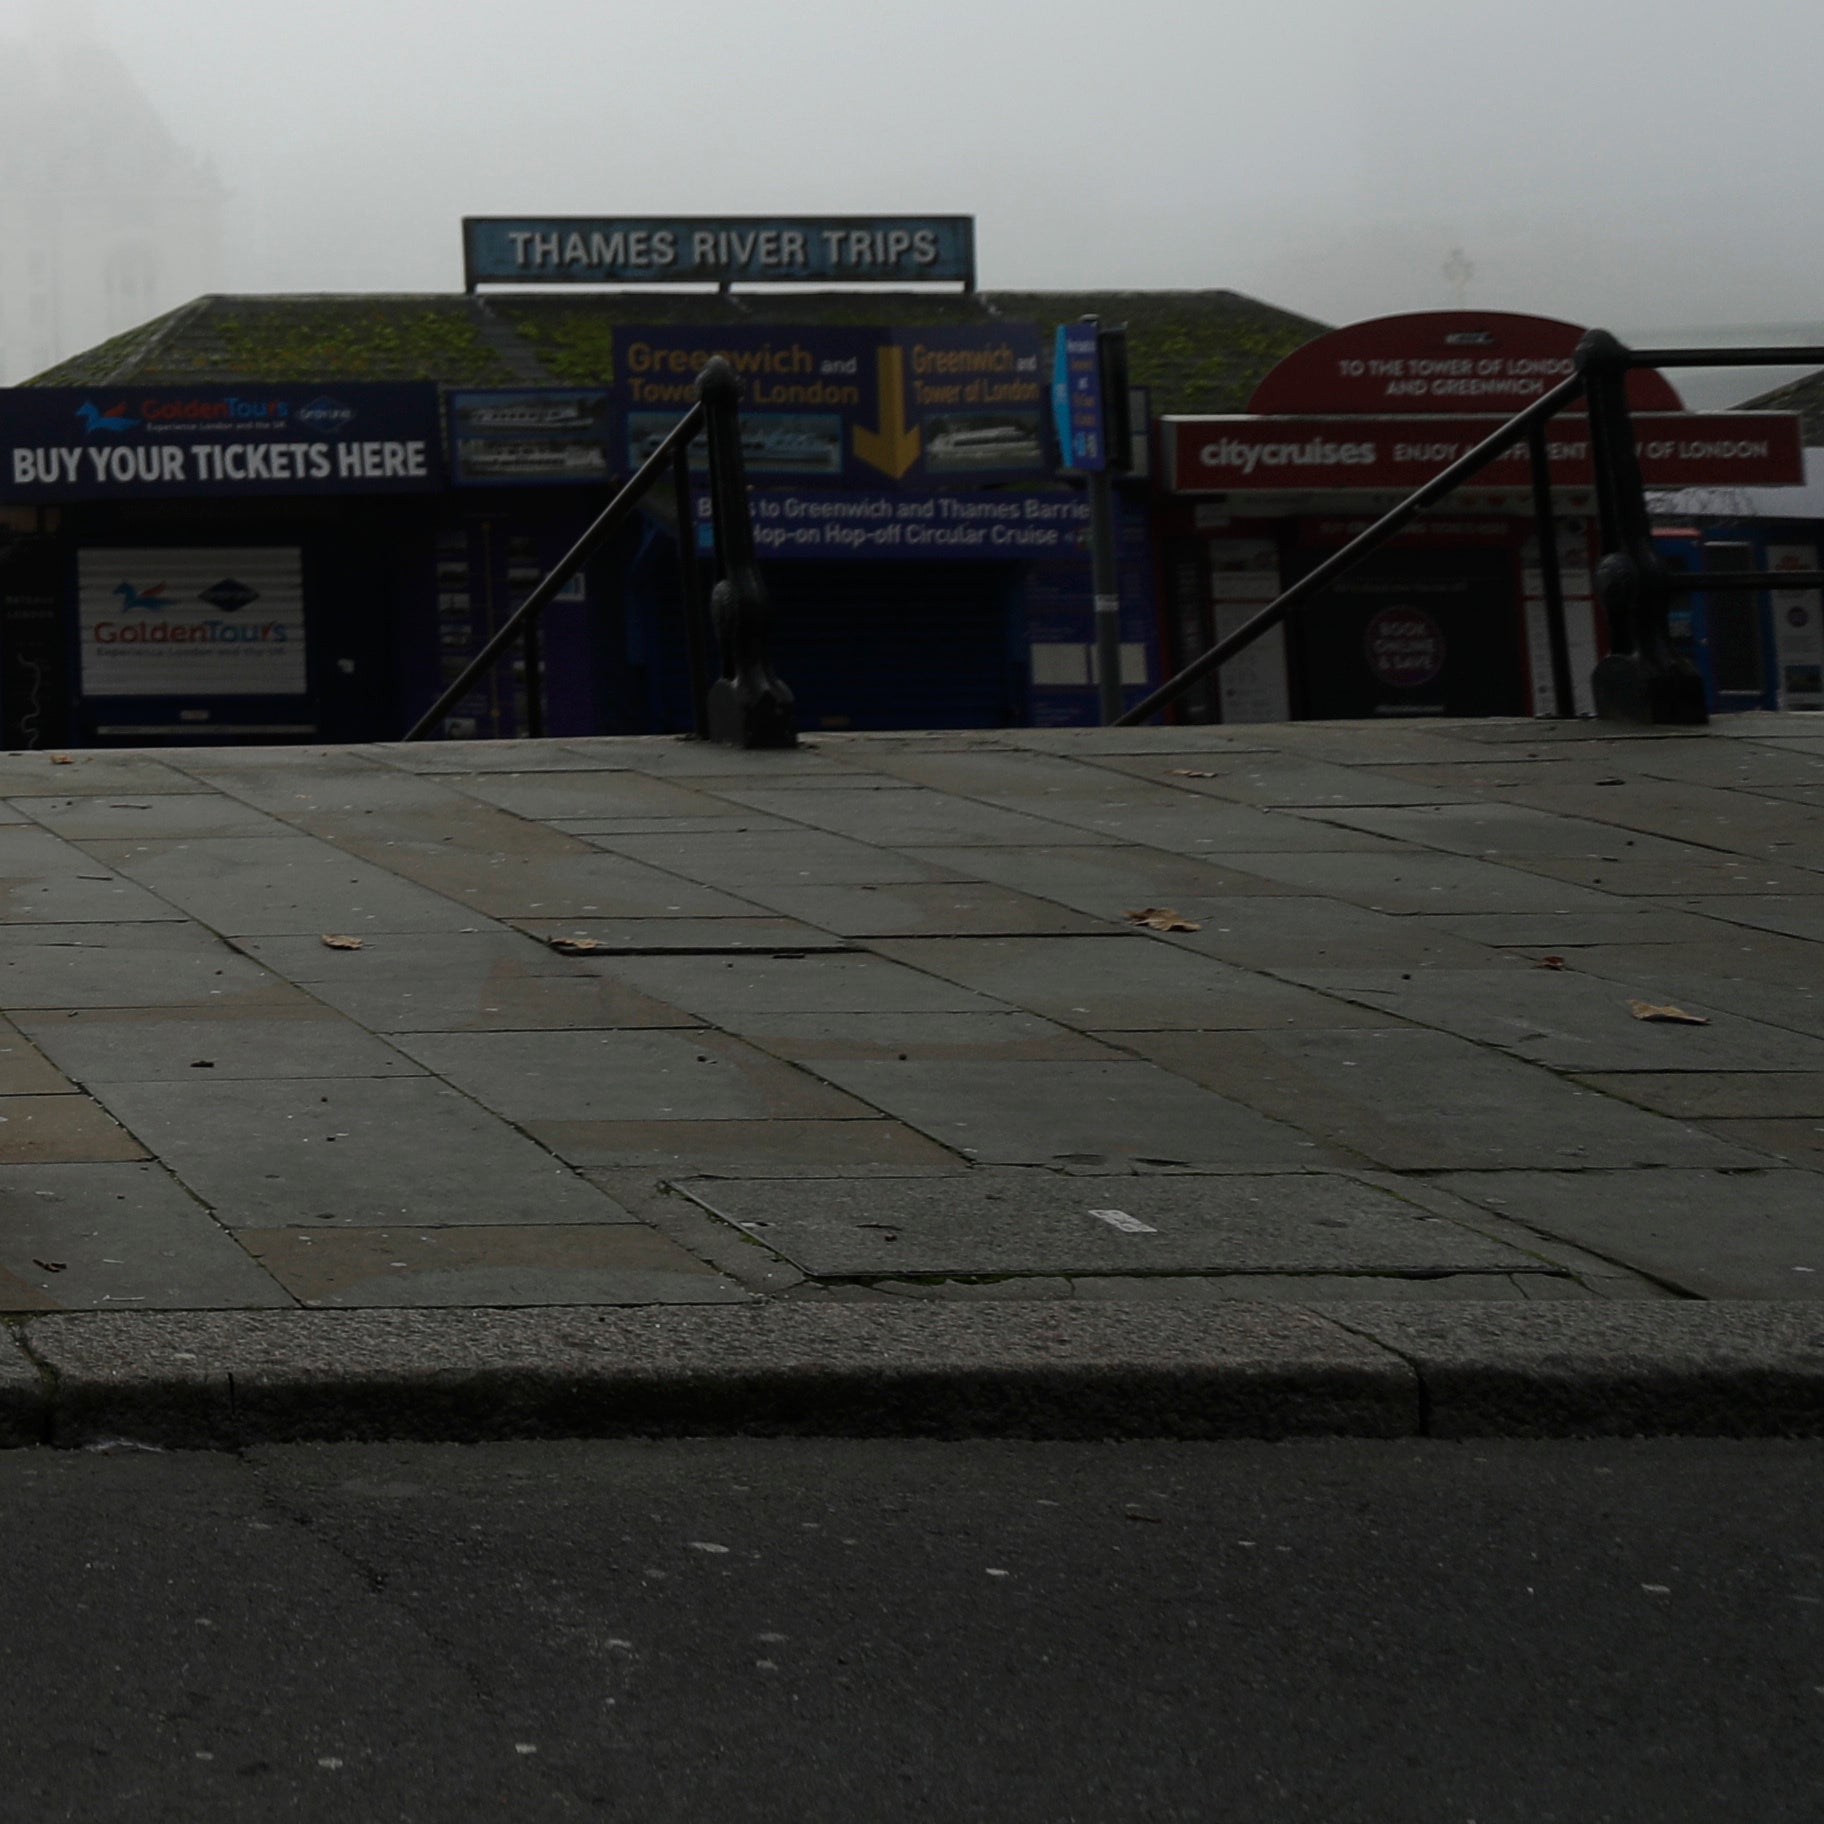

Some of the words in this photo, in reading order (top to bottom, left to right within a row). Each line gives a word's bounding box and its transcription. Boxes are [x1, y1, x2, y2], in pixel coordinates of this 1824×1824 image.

[508, 230, 679, 267] THAMES
[692, 229, 807, 267] RIVER
[823, 229, 939, 266] TRIPS
[820, 356, 858, 375] and
[912, 342, 1016, 374] Greenwich
[1017, 355, 1038, 373] and
[1339, 358, 1365, 377] TO
[1368, 359, 1405, 376] THE
[1408, 358, 1474, 376] TOWER
[1477, 358, 1504, 376] OF
[1506, 358, 1577, 376] LONDO
[627, 377, 697, 403] Towe
[754, 379, 860, 405] London
[912, 379, 962, 405] Tower
[983, 378, 1041, 403] London
[1385, 378, 1429, 396] AND
[1430, 378, 1545, 396] GREENWICH
[12, 446, 84, 485] BUY
[86, 444, 187, 482] YOUR
[190, 442, 334, 481] TICKETS
[337, 439, 429, 479] HERE
[1200, 436, 1378, 476] citycruises
[1391, 442, 1460, 463] ENJOY
[1648, 440, 1677, 459] OF
[1678, 439, 1770, 459] LONDON
[759, 499, 782, 519] to
[784, 497, 894, 520] Greenwich
[895, 498, 936, 520] and
[937, 498, 1022, 520] Thames
[1023, 498, 1091, 520] Barrie
[752, 523, 821, 549] op-on
[823, 523, 902, 550] Hop-off
[905, 522, 989, 546] Circular
[990, 523, 1060, 546] Cruise
[93, 620, 289, 645] GoldenTours
